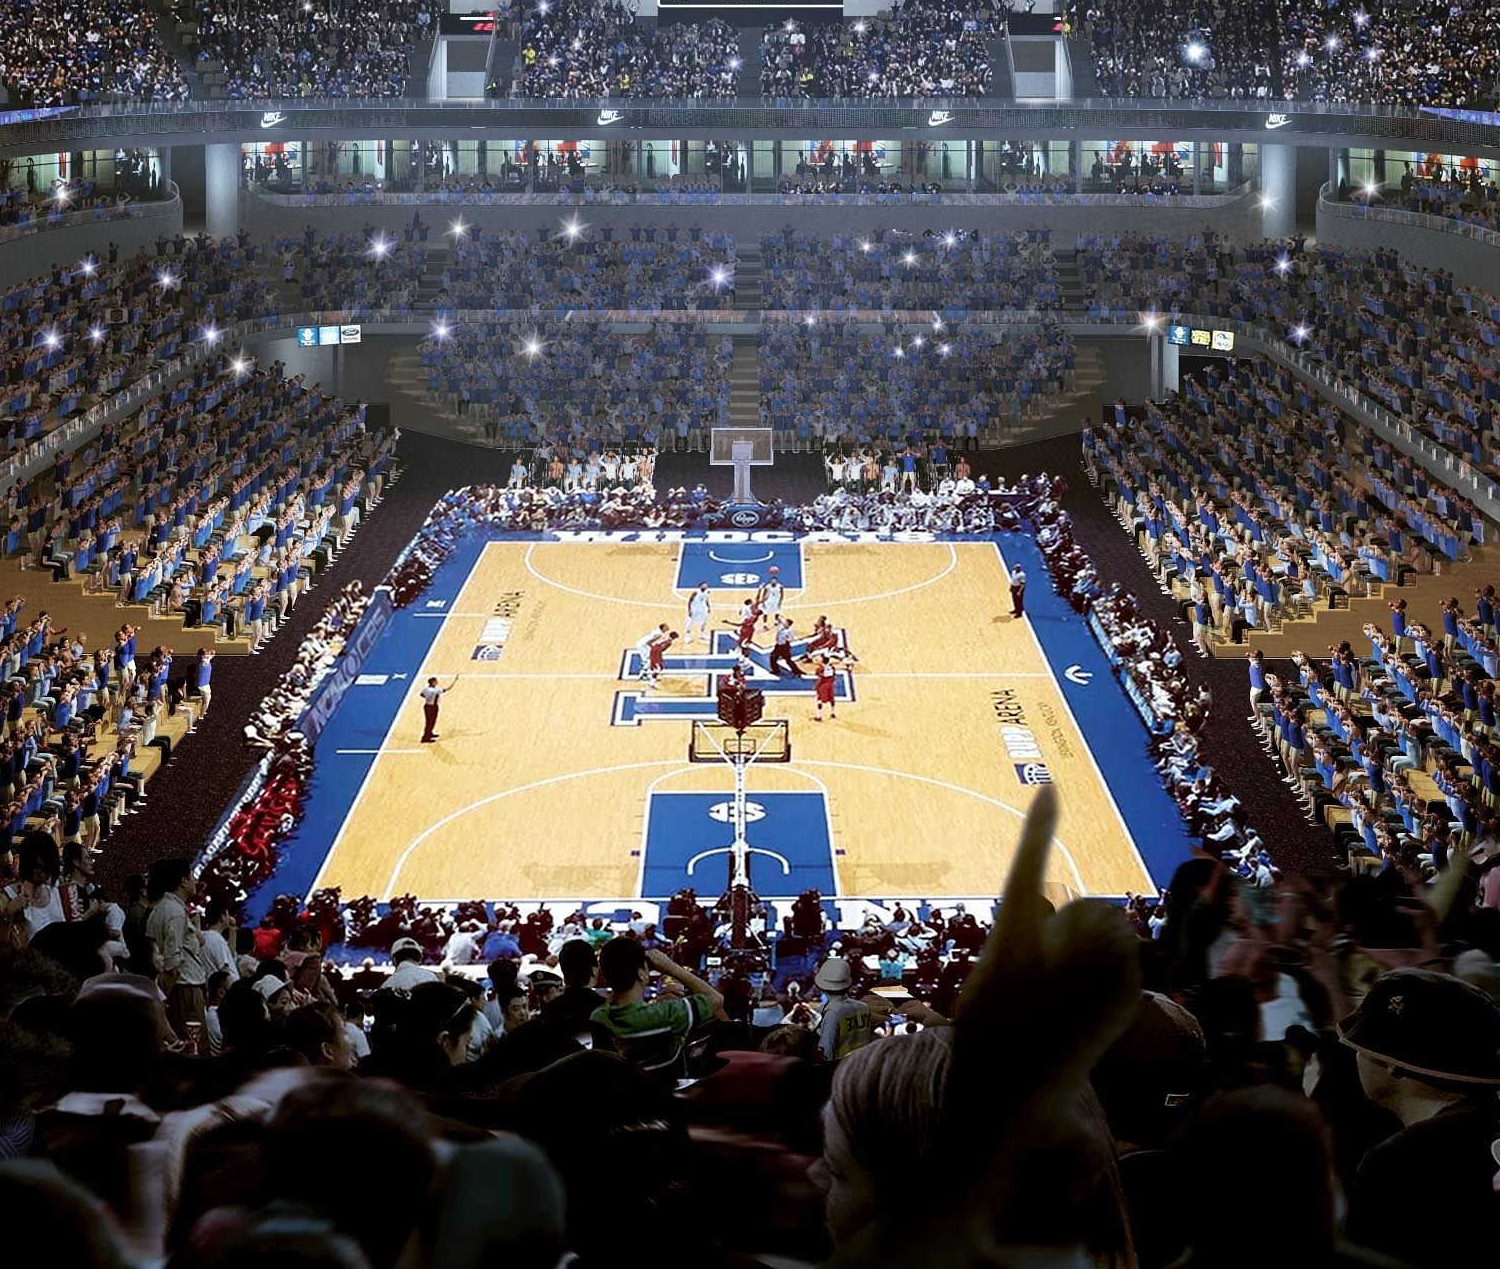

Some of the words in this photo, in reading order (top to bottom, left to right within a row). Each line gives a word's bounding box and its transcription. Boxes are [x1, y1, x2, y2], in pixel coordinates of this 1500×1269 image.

[264, 111, 281, 122] NIKE
[601, 109, 618, 119] NIKE
[932, 110, 950, 120] NIKE
[1269, 113, 1287, 123] NIKE
[721, 573, 760, 586] SEC
[990, 688, 1028, 726] ARENA
